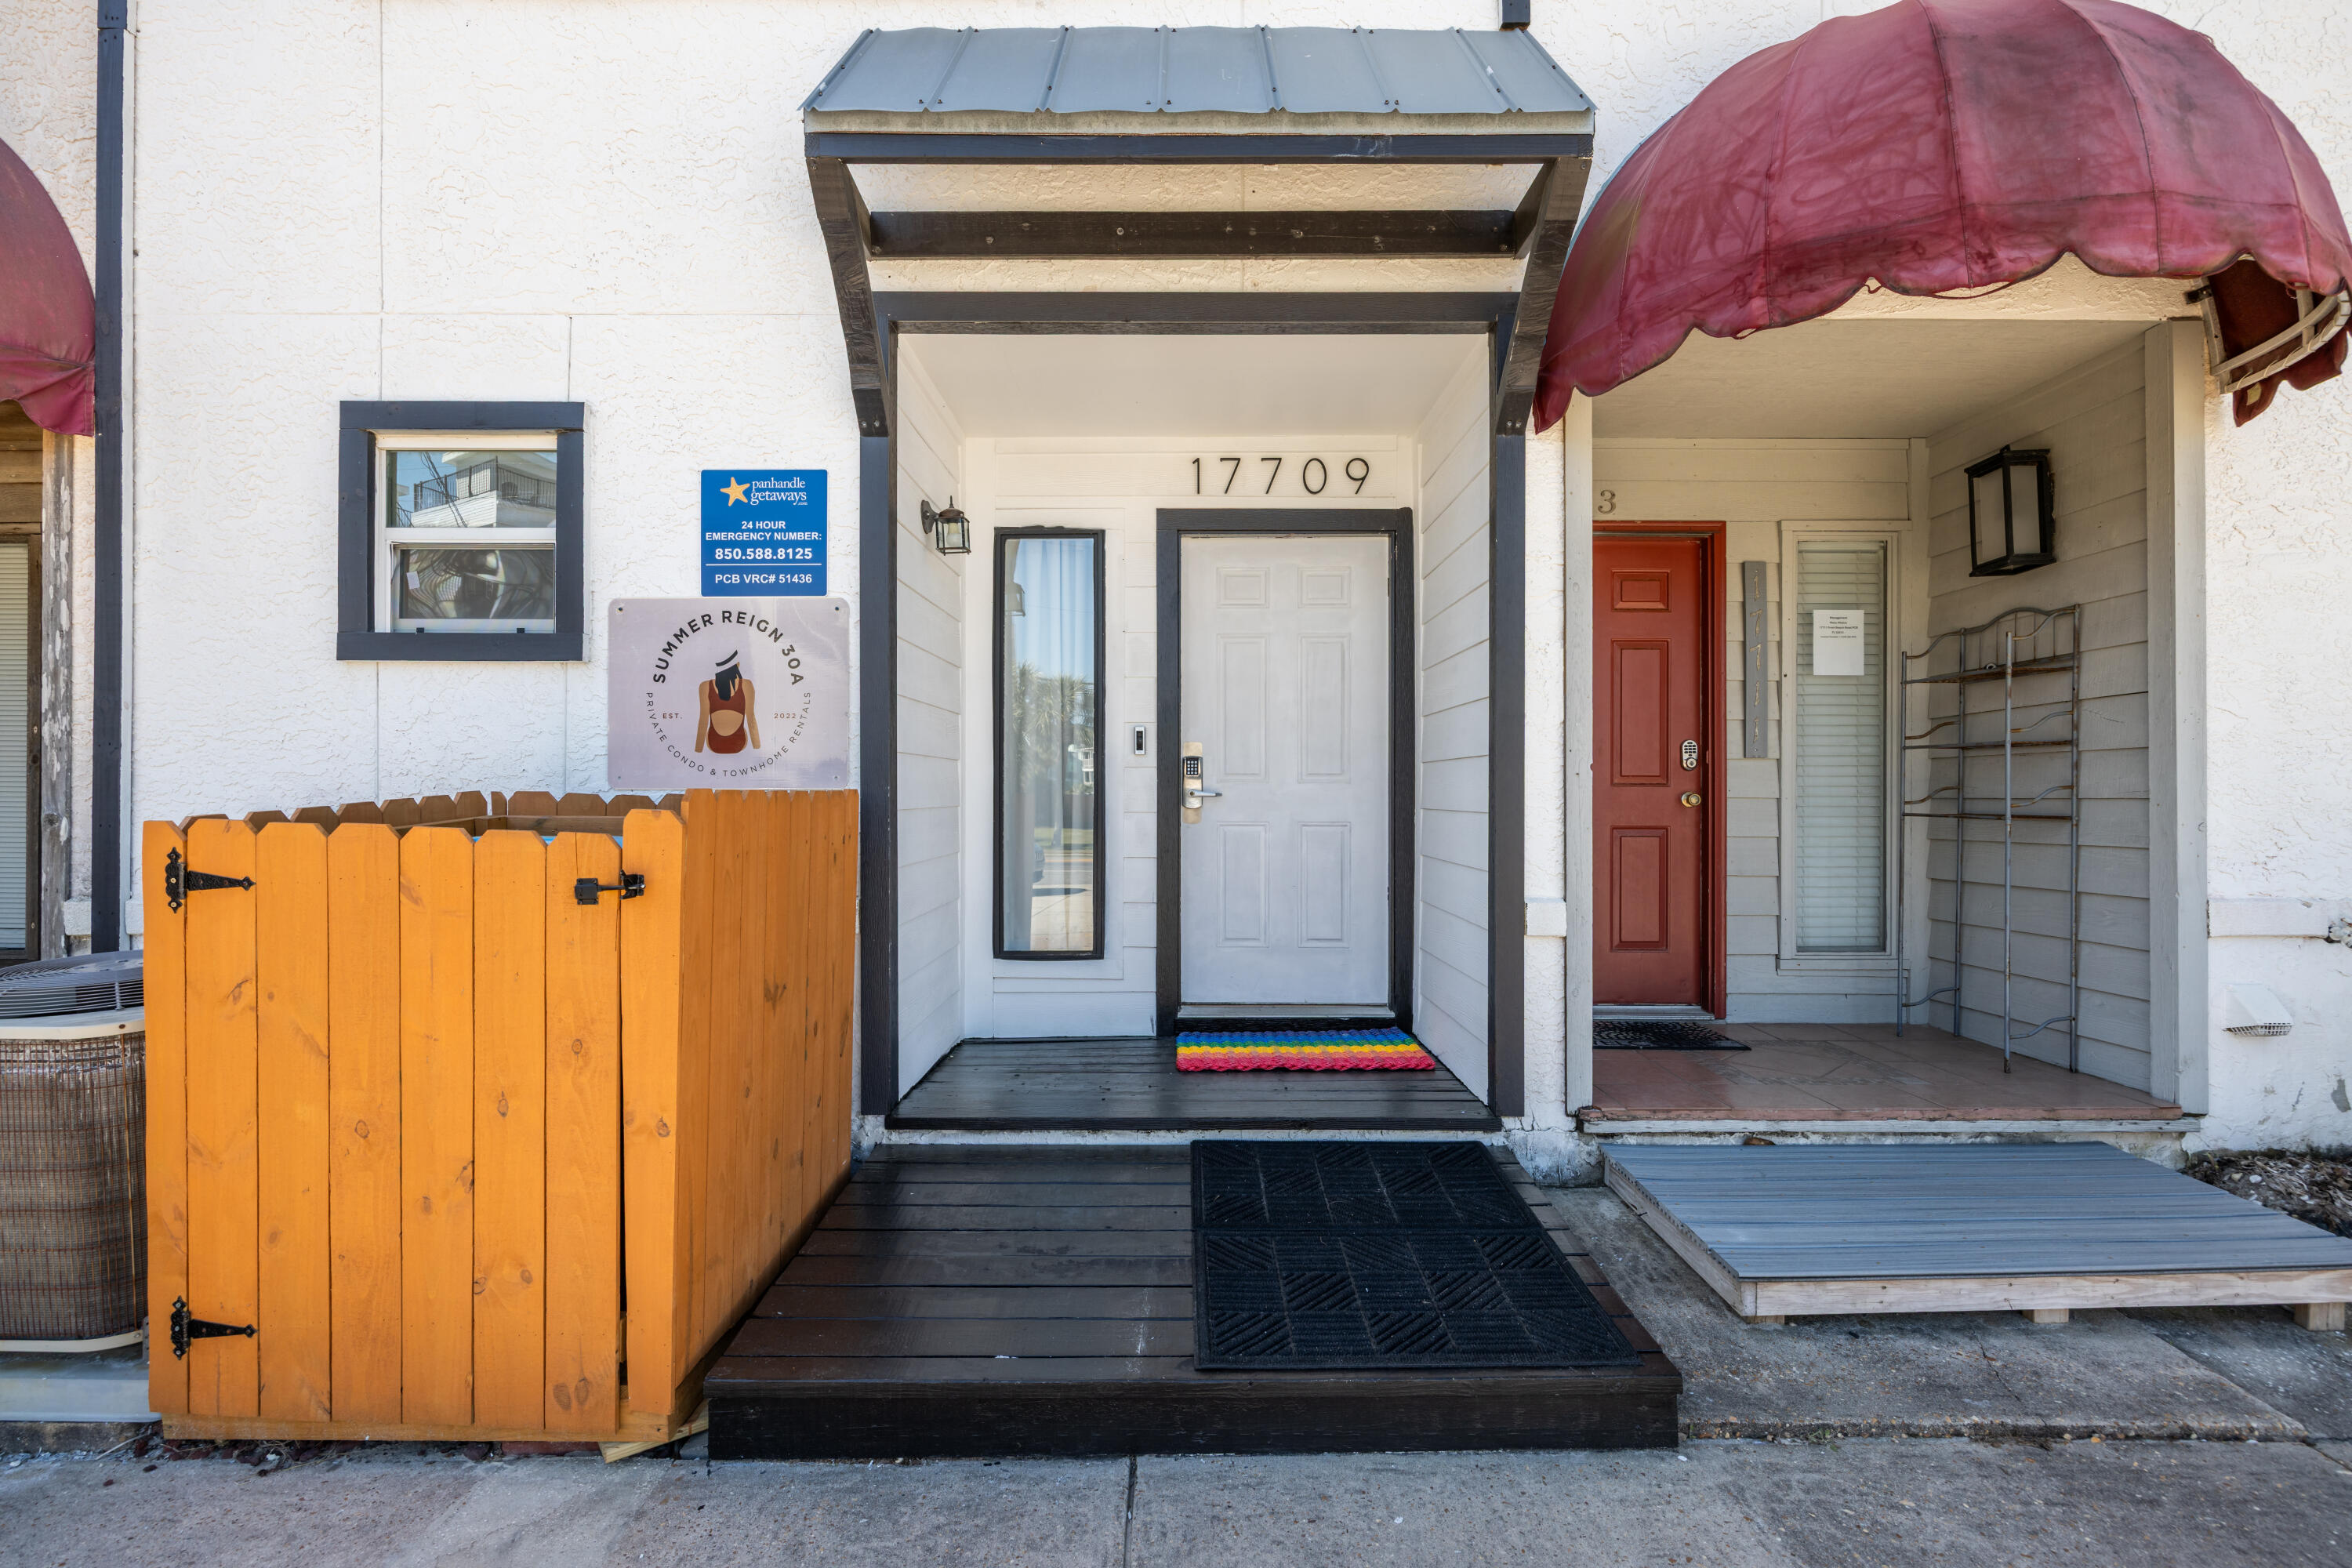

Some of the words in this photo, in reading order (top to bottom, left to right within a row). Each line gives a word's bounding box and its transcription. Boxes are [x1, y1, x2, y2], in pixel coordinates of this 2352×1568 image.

[1192, 457, 1370, 495] 17709
[751, 477, 806, 492] panhandle
[750, 491, 807, 506] getaways
[1597, 489, 1617, 514] 3
[741, 521, 753, 529] 24
[756, 521, 786, 529] HOUR
[705, 532, 771, 541] EMERGENCY
[774, 532, 822, 540] NUMBER:
[714, 547, 812, 560] 850.588.8125
[714, 574, 740, 583] PCB
[742, 574, 776, 583] VRC#
[779, 574, 812, 583] 51436
[652, 613, 714, 684] SUMMER
[721, 610, 784, 644] REIGN
[782, 644, 804, 685] 30A
[645, 692, 668, 742] PRIVATE
[667, 744, 705, 771] CONDO
[723, 746, 789, 777] TOWNHOME
[789, 691, 811, 744] RENTALS
